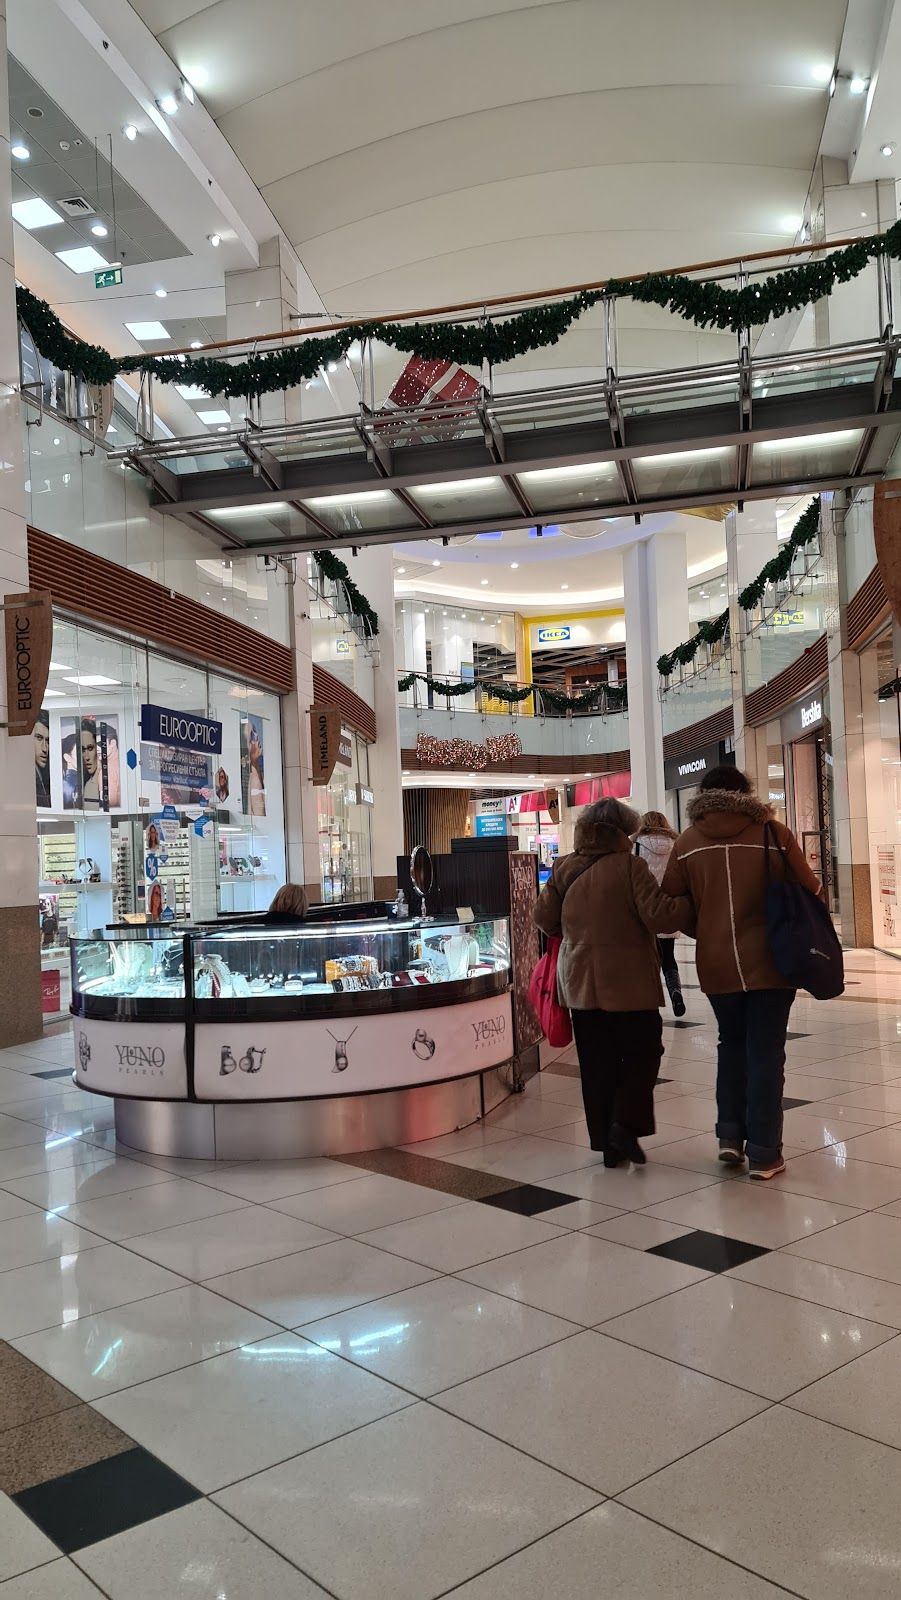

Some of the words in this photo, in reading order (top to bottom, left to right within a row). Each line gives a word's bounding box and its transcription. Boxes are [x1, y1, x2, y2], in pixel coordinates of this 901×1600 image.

[15, 616, 32, 711] EUROOPTIC
[801, 700, 822, 728] Bershka
[160, 714, 217, 746] EUROOPTIC
[319, 715, 329, 770] TIMELAND
[677, 758, 707, 776] VIVACOM
[508, 796, 517, 813] A1
[548, 800, 558, 810] A1
[472, 1014, 506, 1042] YUNO
[114, 1044, 165, 1068] YUNO
